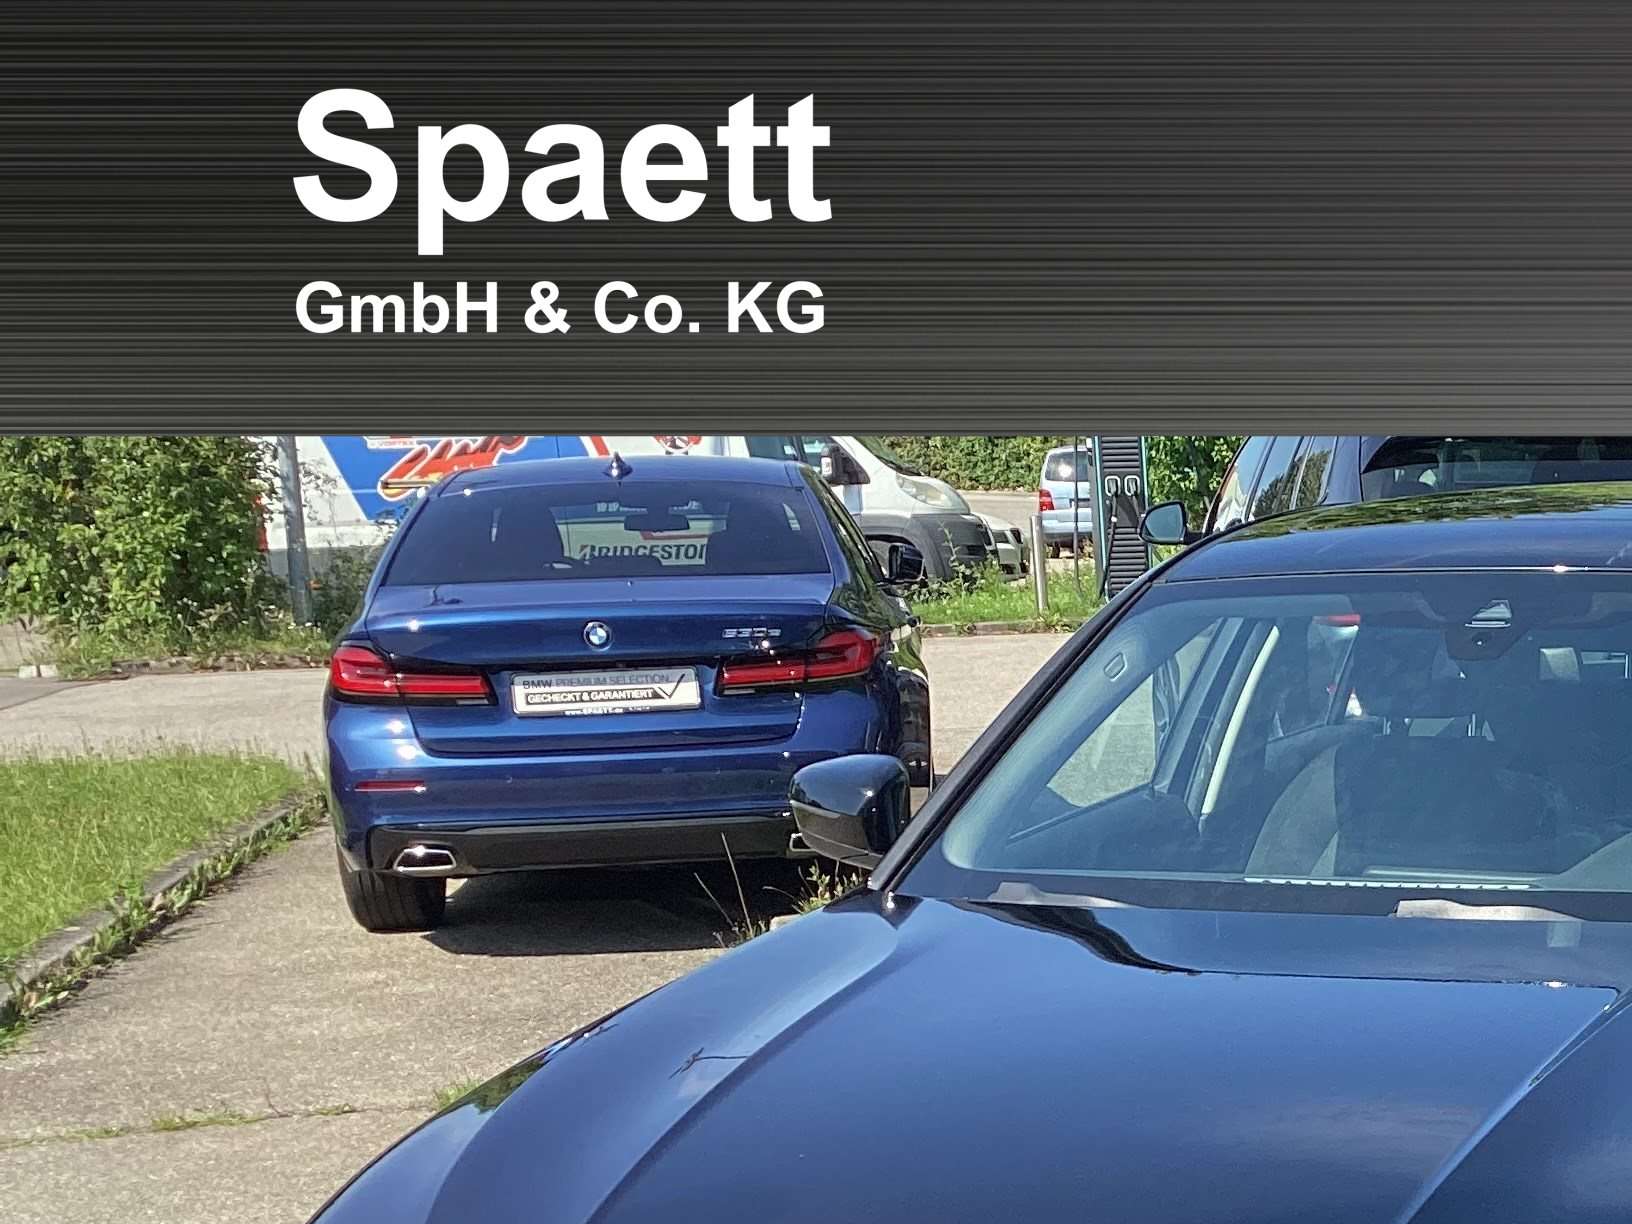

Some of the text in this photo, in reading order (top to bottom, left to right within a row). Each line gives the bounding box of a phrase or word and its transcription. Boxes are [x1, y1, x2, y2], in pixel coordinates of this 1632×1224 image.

[523, 679, 552, 689] BMW
[556, 675, 607, 686] PREMIUM
[527, 689, 654, 704] GECHECKT & GARANTIERT
